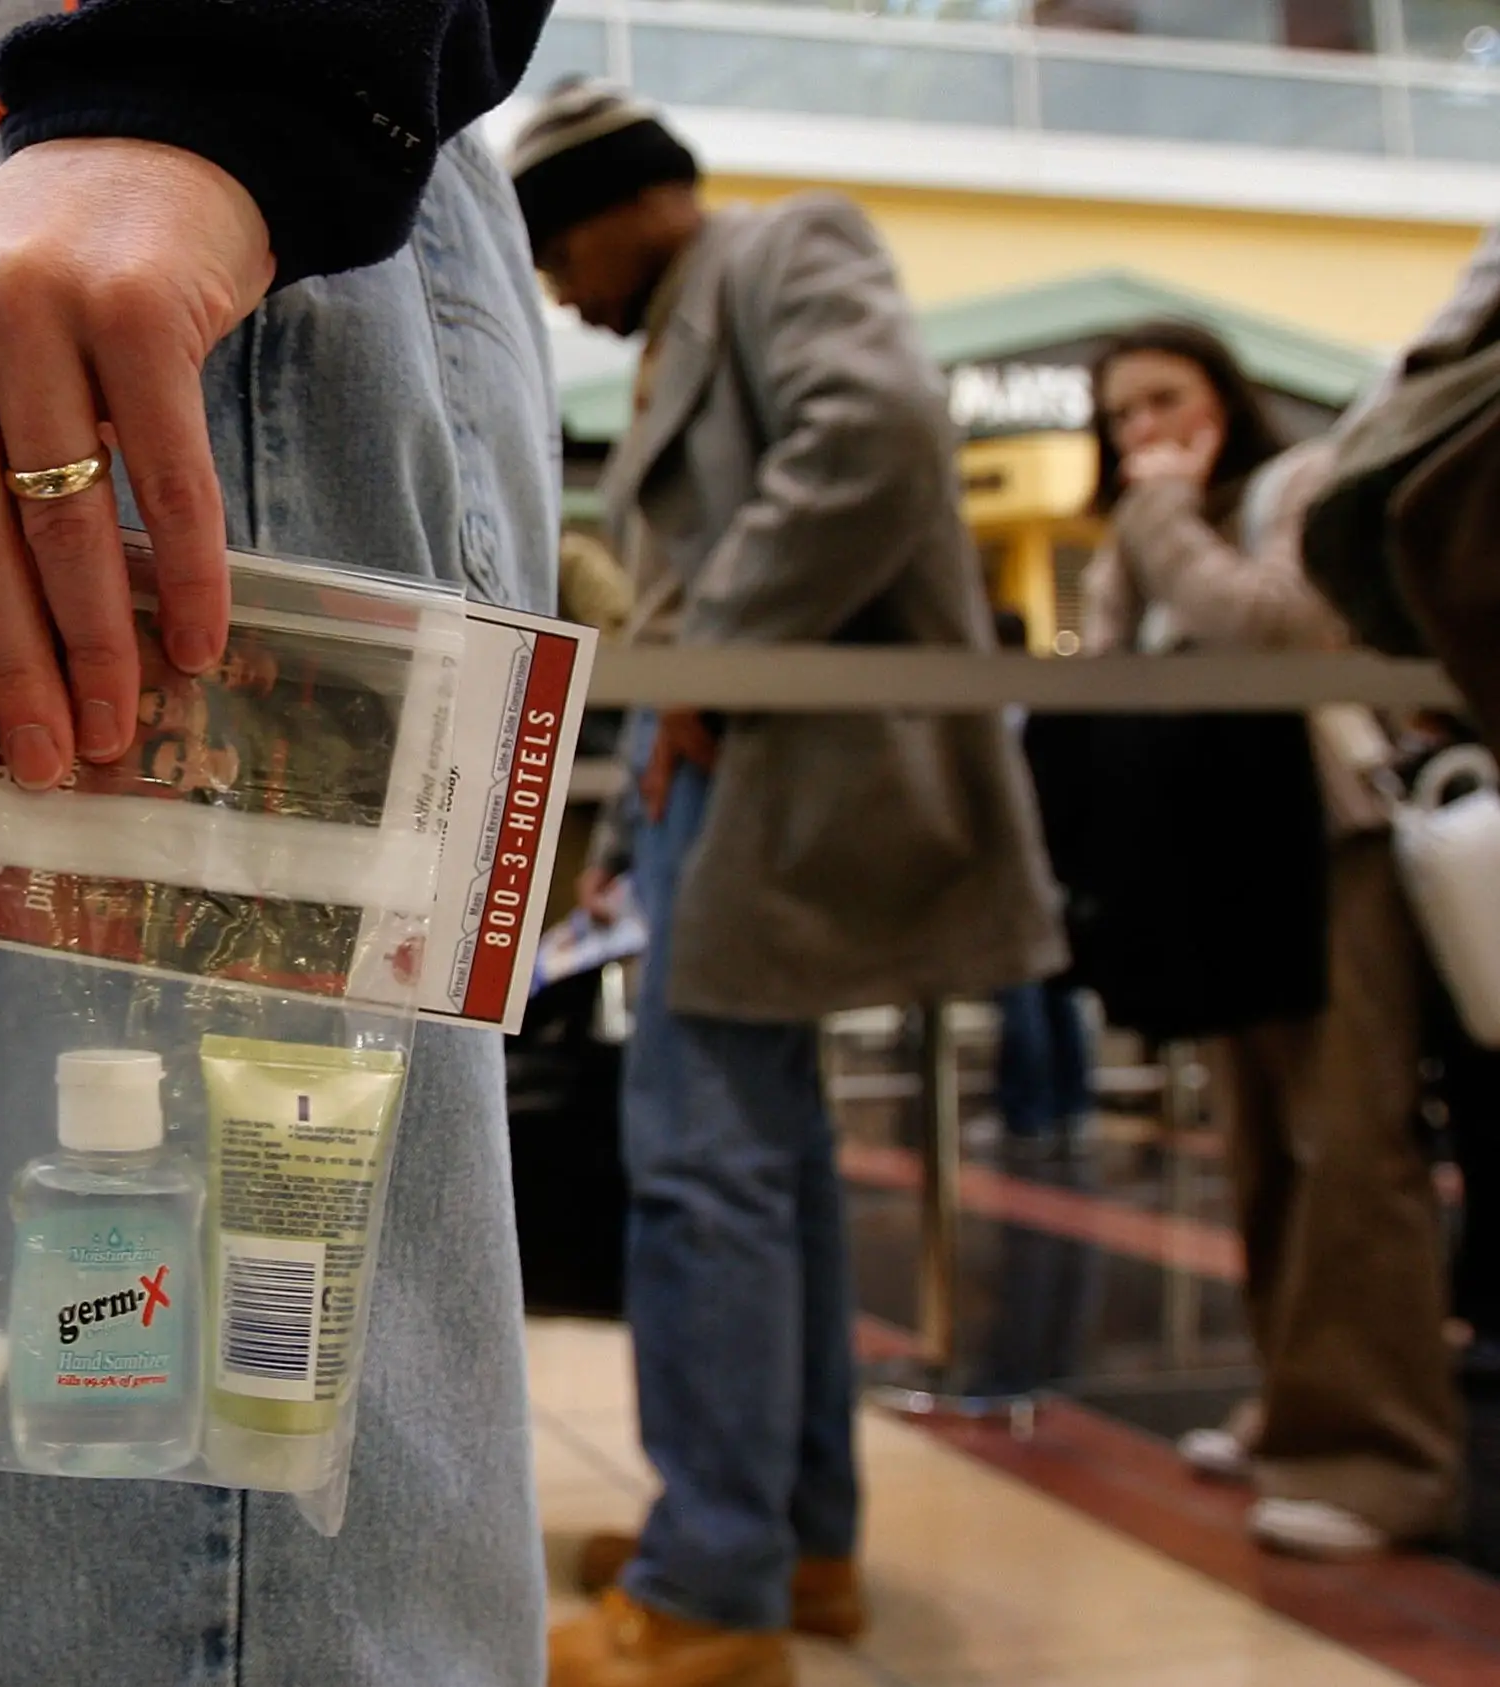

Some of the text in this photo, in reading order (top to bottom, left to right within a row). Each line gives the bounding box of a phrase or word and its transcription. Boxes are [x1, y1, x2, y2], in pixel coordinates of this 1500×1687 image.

[372, 112, 420, 148] FIT
[480, 794, 504, 863] Guest Reviews
[484, 709, 556, 948] 800-3-HOTELS
[468, 891, 484, 917] Maps
[57, 1349, 171, 1372] Hand Sanitizer
